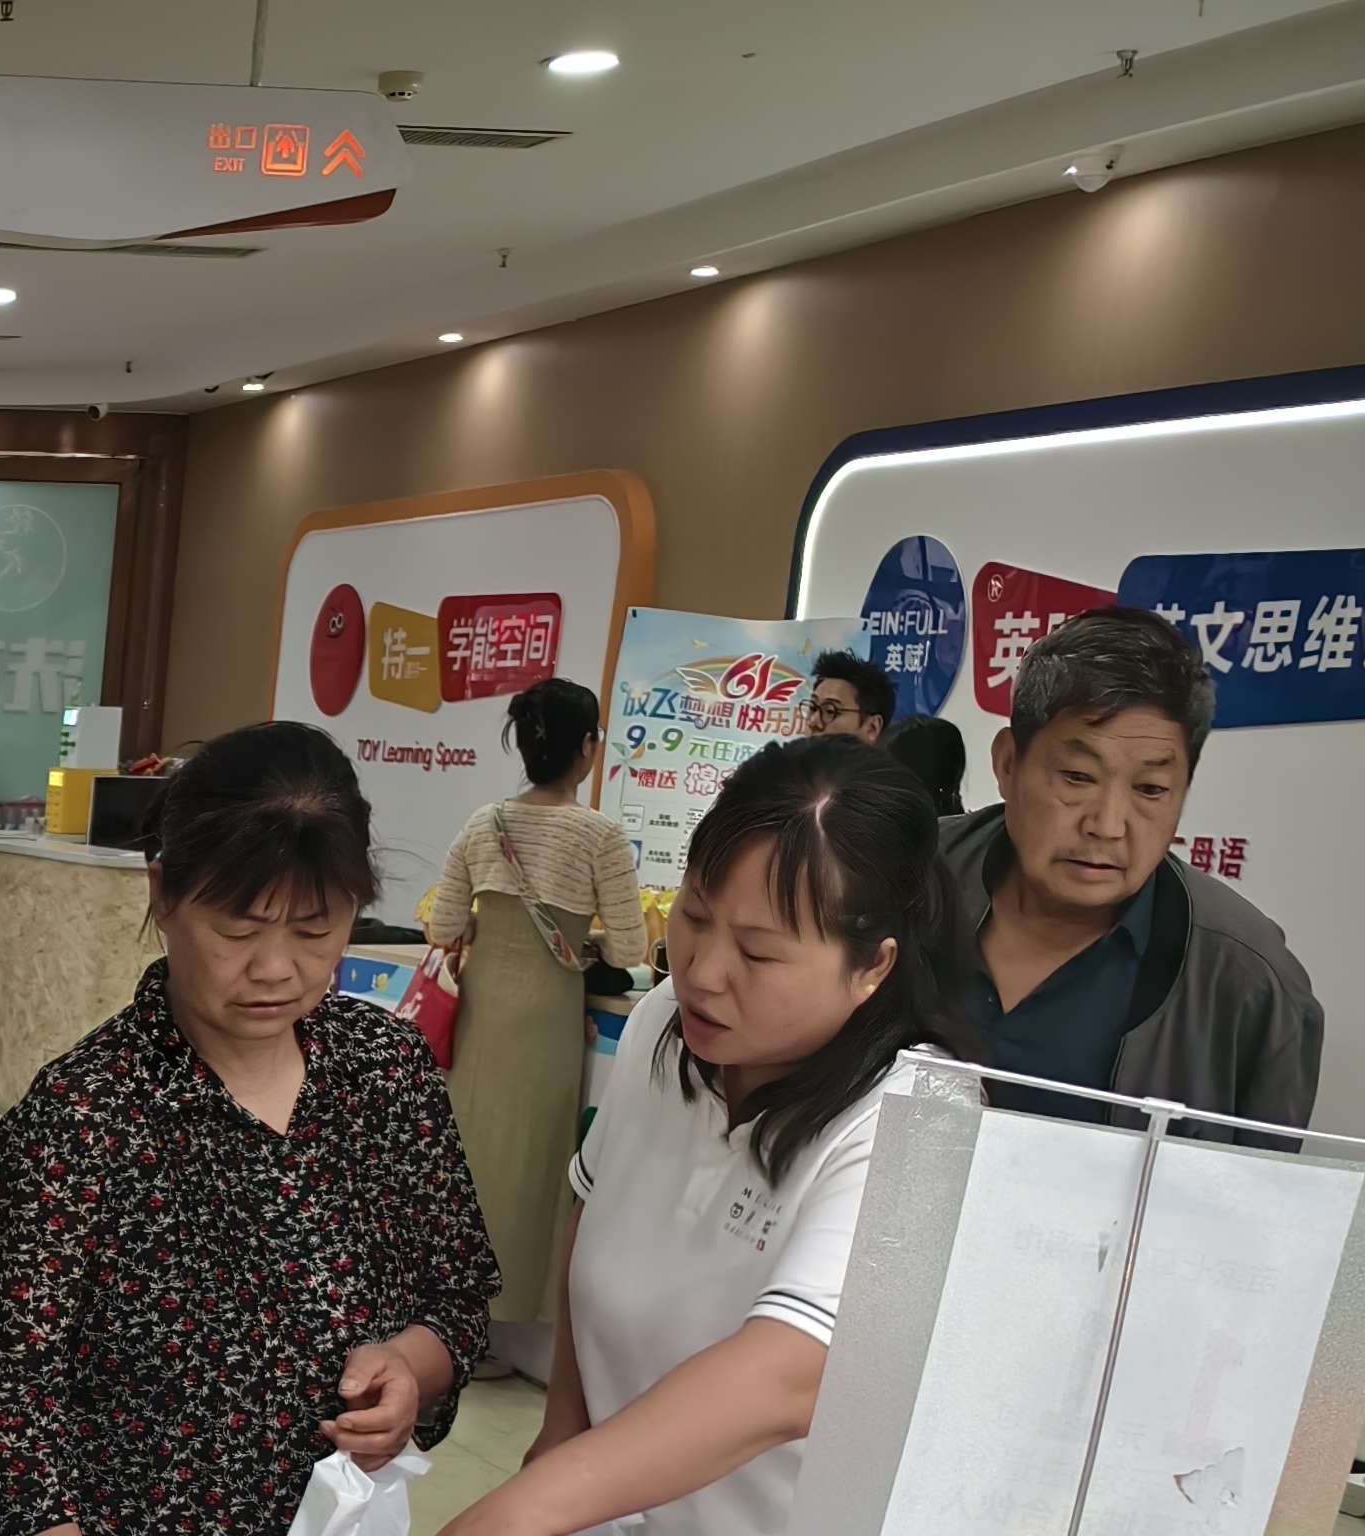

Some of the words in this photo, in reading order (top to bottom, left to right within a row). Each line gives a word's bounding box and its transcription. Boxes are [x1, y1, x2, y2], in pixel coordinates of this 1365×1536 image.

[209, 122, 256, 149] 出口
[215, 157, 245, 172] EXIT
[868, 610, 948, 637] EIN:FULL
[1153, 594, 1365, 674] 文思维
[382, 628, 430, 680] 特一
[447, 614, 554, 671] 学能空间
[884, 642, 929, 674] 英赋
[623, 687, 733, 730] 放飞梦想
[626, 724, 684, 752] 9.9
[382, 740, 432, 772] Learning
[435, 741, 477, 772] Space
[637, 768, 678, 790] 赠送
